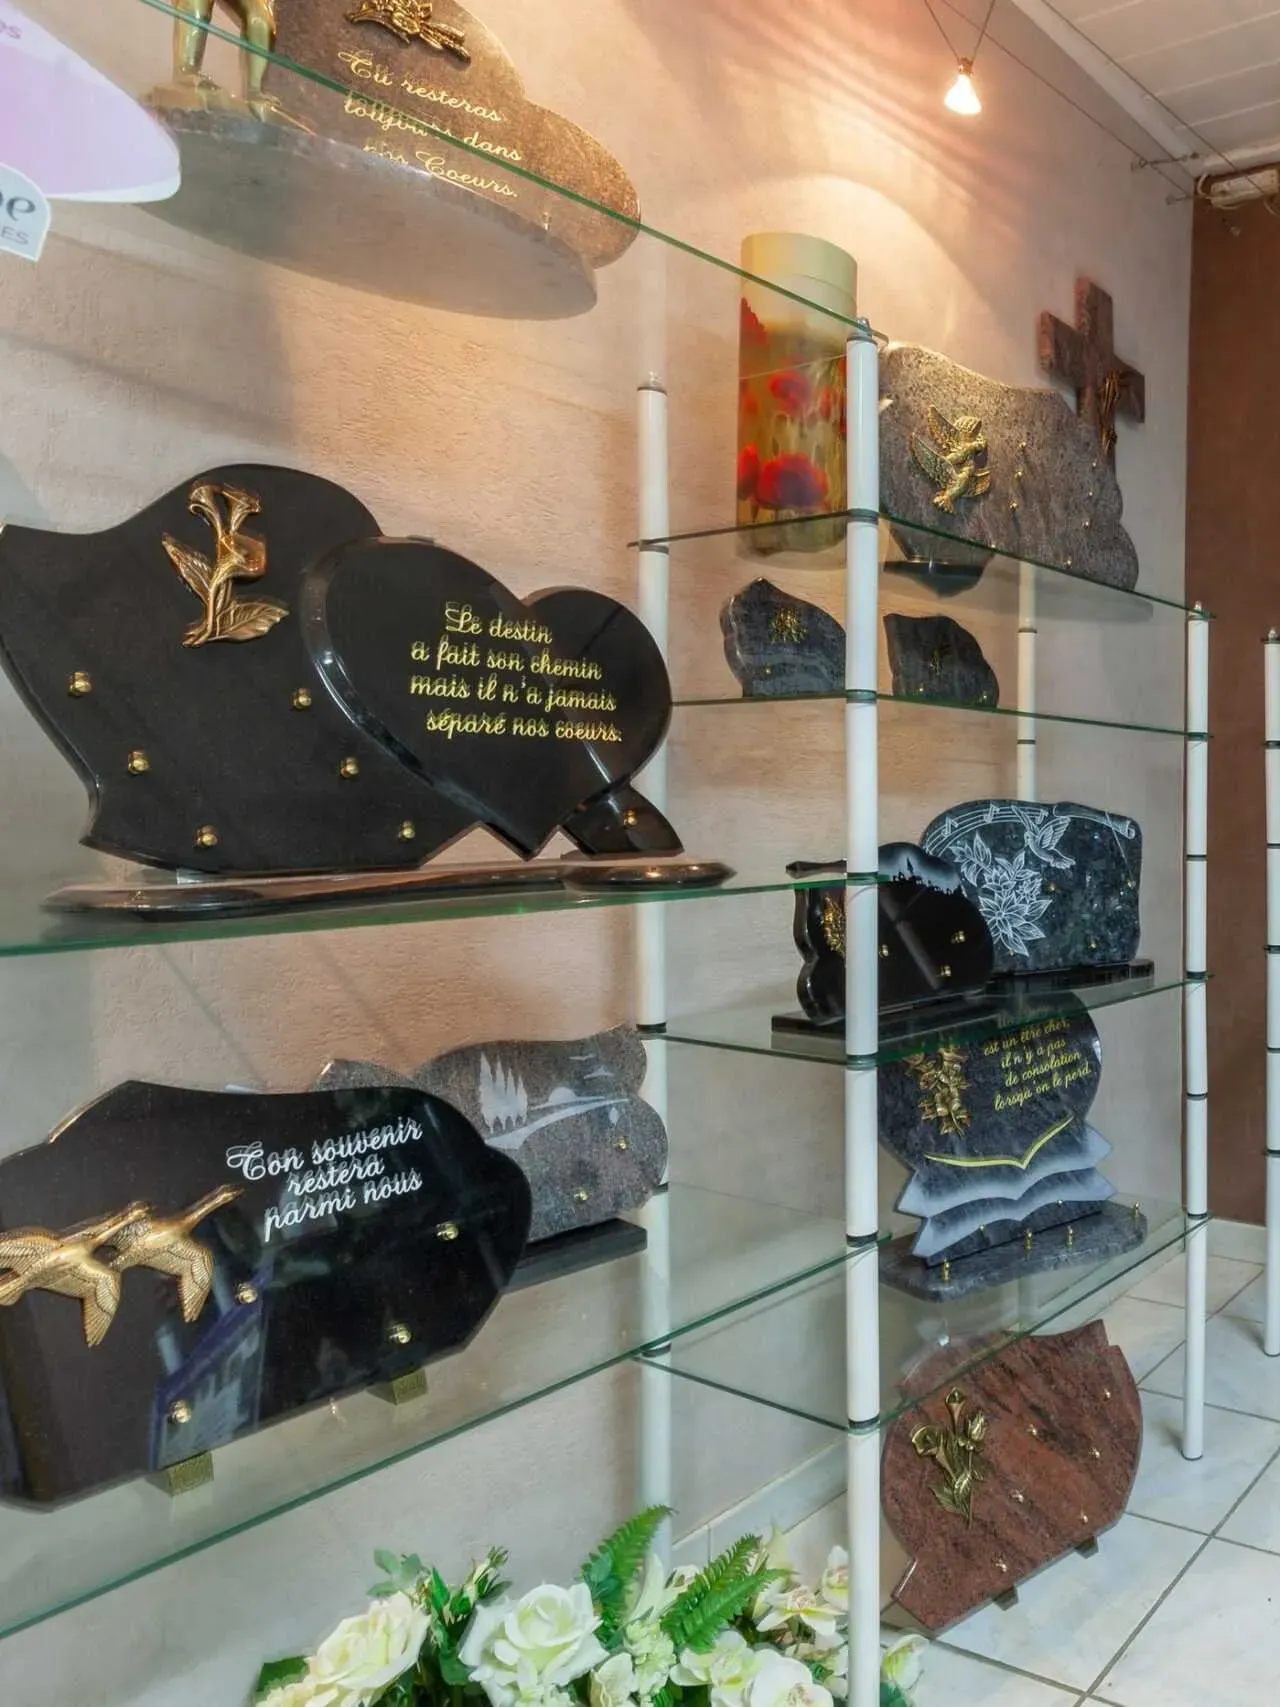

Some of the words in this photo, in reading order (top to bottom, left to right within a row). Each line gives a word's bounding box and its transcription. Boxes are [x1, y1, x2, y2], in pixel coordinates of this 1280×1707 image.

[401, 78, 502, 122] resteras
[463, 132, 522, 161] dans
[445, 608, 482, 634] Le
[489, 613, 552, 644] destin
[411, 647, 429, 661] a
[436, 640, 480, 670] fait
[487, 655, 525, 672] son
[530, 653, 602, 680] chemin
[410, 678, 470, 698] mais
[477, 678, 496, 700] il
[544, 686, 616, 712] jamais
[426, 714, 506, 739] séparé
[512, 722, 549, 737] nos
[984, 1040, 999, 1056] est
[1002, 1037, 1017, 1048] un
[1001, 1052, 1011, 1068] il
[1037, 1047, 1045, 1055] a
[1047, 1040, 1066, 1056] pas
[1005, 1072, 1018, 1087] de
[1022, 1051, 1081, 1080] consolation
[1053, 1072, 1061, 1087] le
[226, 1147, 304, 1180] Ton
[312, 1123, 423, 1164] souvenir
[287, 1158, 385, 1196] restera
[264, 1188, 356, 1242] parmi
[363, 1174, 423, 1204] nous
